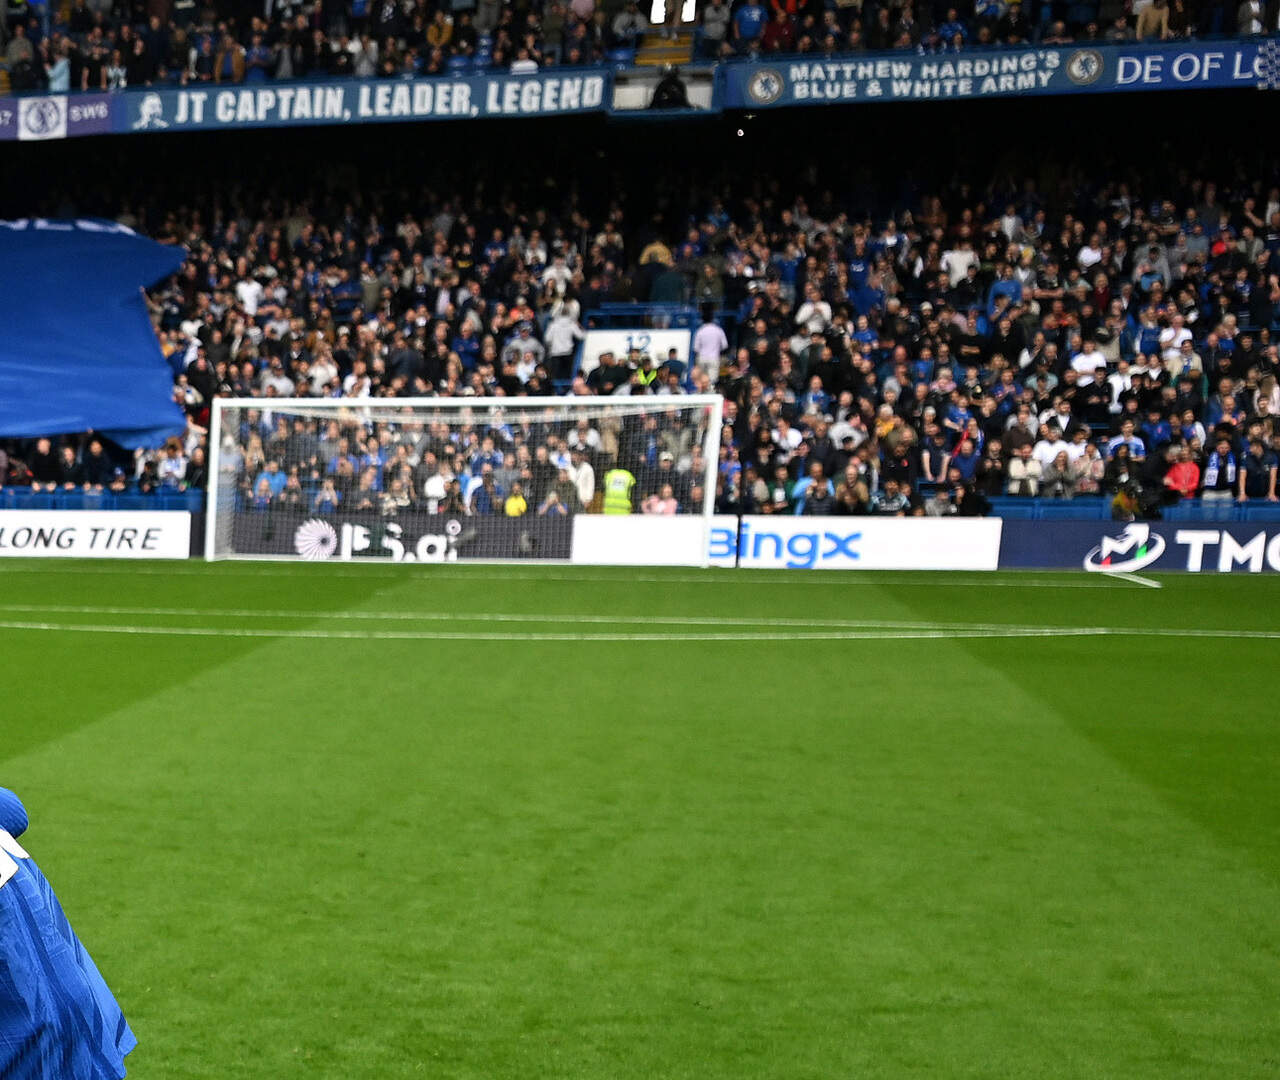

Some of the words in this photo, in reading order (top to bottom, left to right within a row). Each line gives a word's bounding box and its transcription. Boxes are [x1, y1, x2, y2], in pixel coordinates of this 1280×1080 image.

[790, 60, 912, 81] MATTHEW
[922, 51, 1060, 80] HARDING'S
[1172, 52, 1224, 82] OF
[794, 81, 857, 99] BLUE
[866, 80, 883, 97] &
[893, 78, 972, 98] WHITE
[981, 69, 1055, 95] ARMY
[175, 91, 207, 124] JT
[216, 87, 351, 122] CAPTAIN,
[358, 80, 479, 118] LEADER,
[485, 76, 604, 112] LEGEND
[89, 527, 163, 550] TIRE
